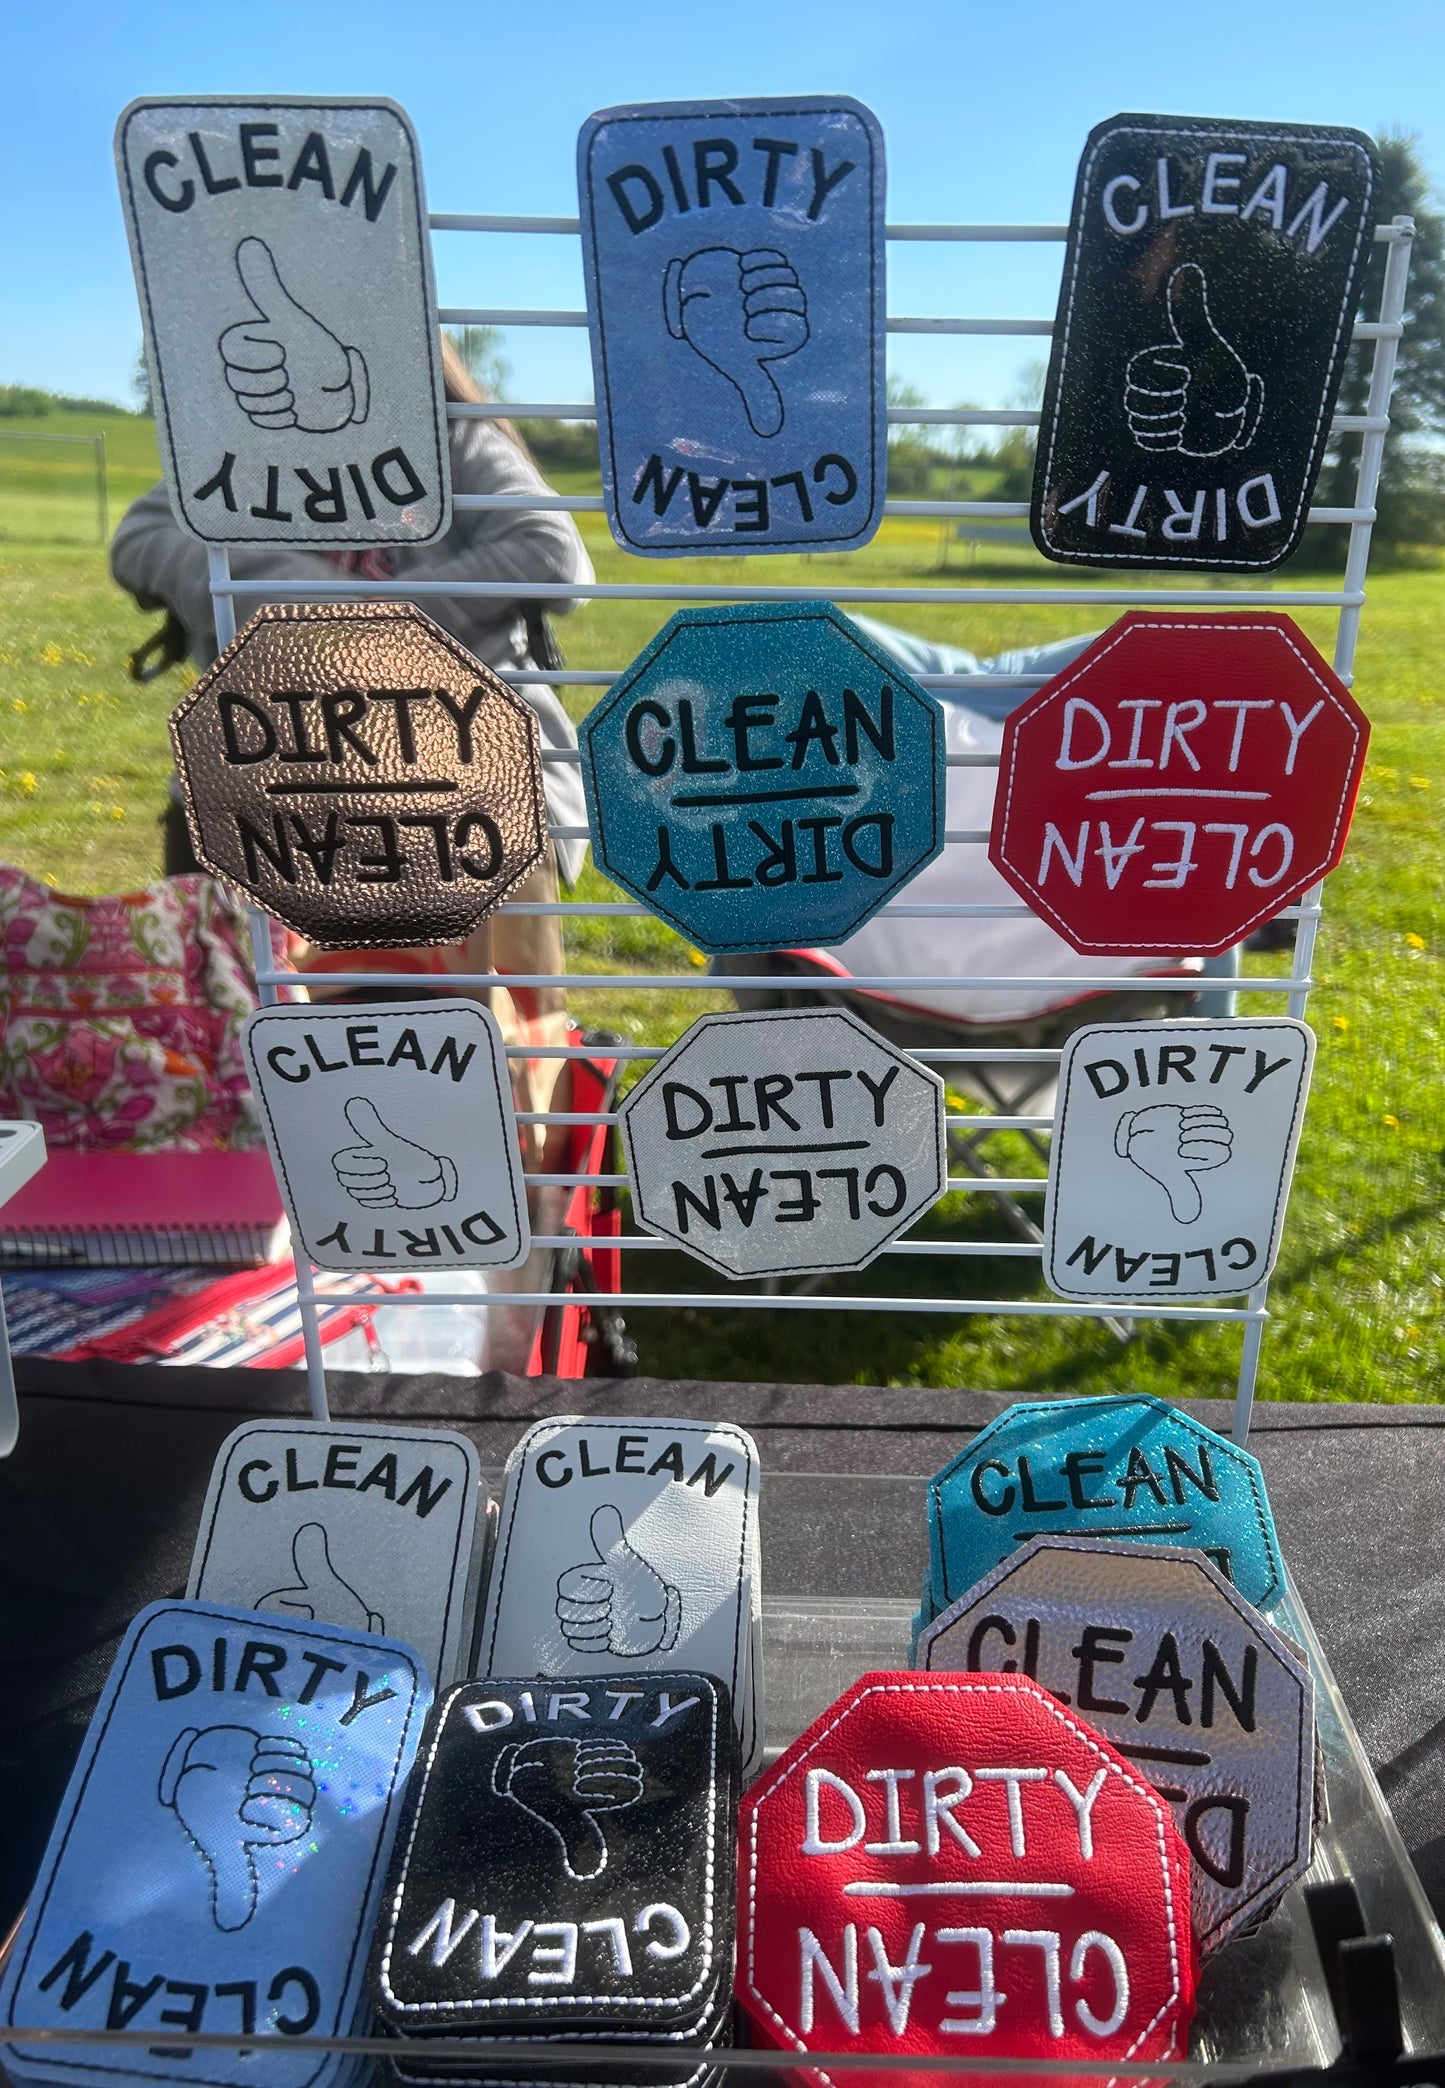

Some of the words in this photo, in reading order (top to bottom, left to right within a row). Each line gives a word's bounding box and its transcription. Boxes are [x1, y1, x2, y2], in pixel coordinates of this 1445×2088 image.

[143, 124, 397, 222] CLEAN
[606, 138, 855, 235] DIRTY
[1103, 153, 1350, 254] CLEAN
[193, 447, 428, 522] DIRTY
[632, 454, 857, 531] CLEAN
[1059, 471, 1281, 541] DIRTY
[217, 687, 485, 765] DIRTY
[625, 686, 895, 776] CLEAN
[1055, 698, 1325, 775] DIRTY
[236, 813, 501, 885] CLEAN
[647, 813, 895, 892] DIRTY
[1037, 817, 1294, 890] CLEAN
[267, 1025, 478, 1084] CLEAN
[1084, 1044, 1292, 1099] DIRTY
[665, 1066, 900, 1141] DIRTY
[316, 1210, 508, 1259] DIRTY
[672, 1164, 907, 1234] CLEAN
[1067, 1234, 1257, 1286] CLEAN
[238, 1444, 454, 1518] CLEAN
[534, 1435, 735, 1499] CLEAN
[971, 1444, 1220, 1516] CLEAN
[150, 1639, 399, 1726] DIRTY
[464, 1691, 701, 1733] DIRTY
[801, 1766, 1107, 1861] DIRTY
[410, 1897, 692, 1984] CLEAN
[38, 1930, 320, 2057] CLEAN
[798, 1921, 1129, 2039] CLEAN
